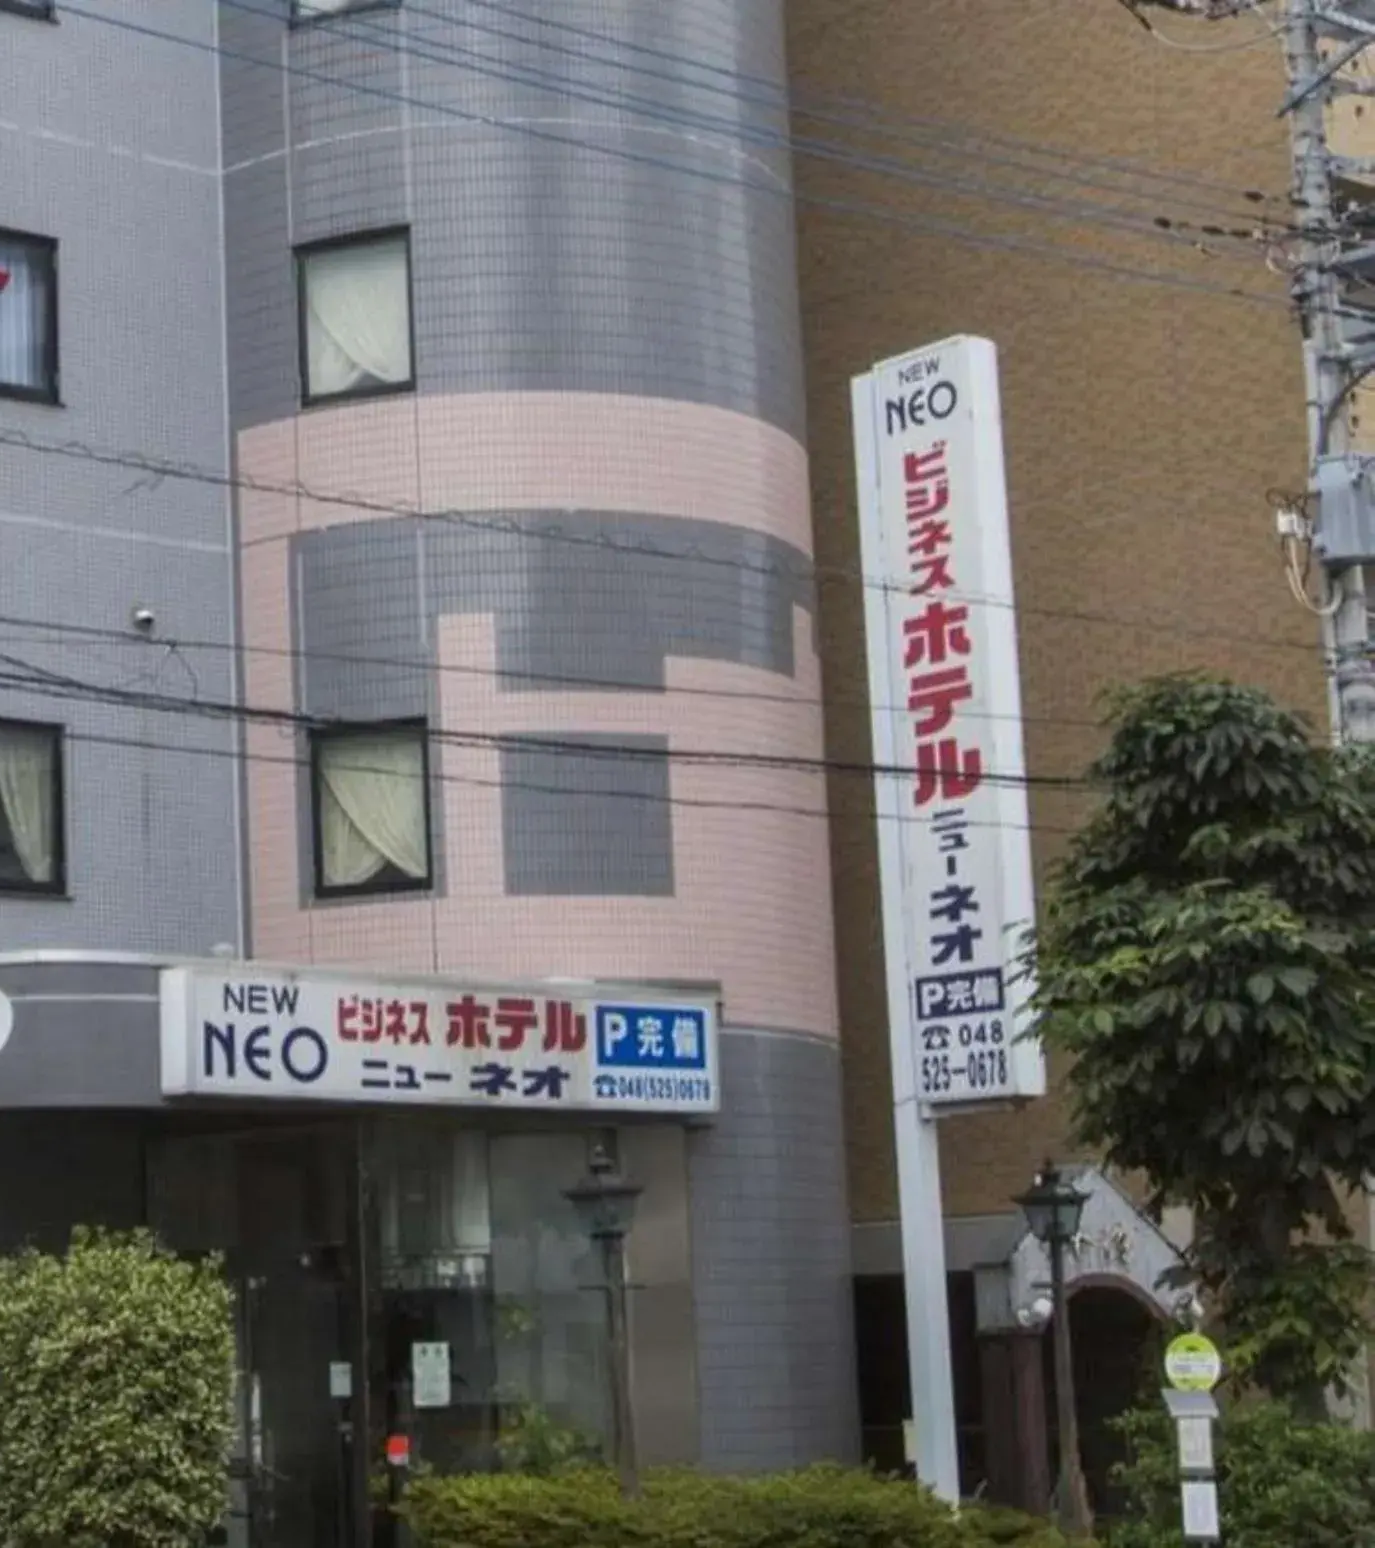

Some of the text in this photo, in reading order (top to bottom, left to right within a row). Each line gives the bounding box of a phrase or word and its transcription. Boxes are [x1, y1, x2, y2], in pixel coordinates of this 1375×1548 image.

[898, 356, 941, 386] NEW
[886, 380, 958, 436] NEO
[224, 983, 299, 1016] NEW
[204, 1021, 328, 1083] NEO
[959, 1022, 1004, 1047] 048
[922, 1049, 1007, 1092] 525-0678
